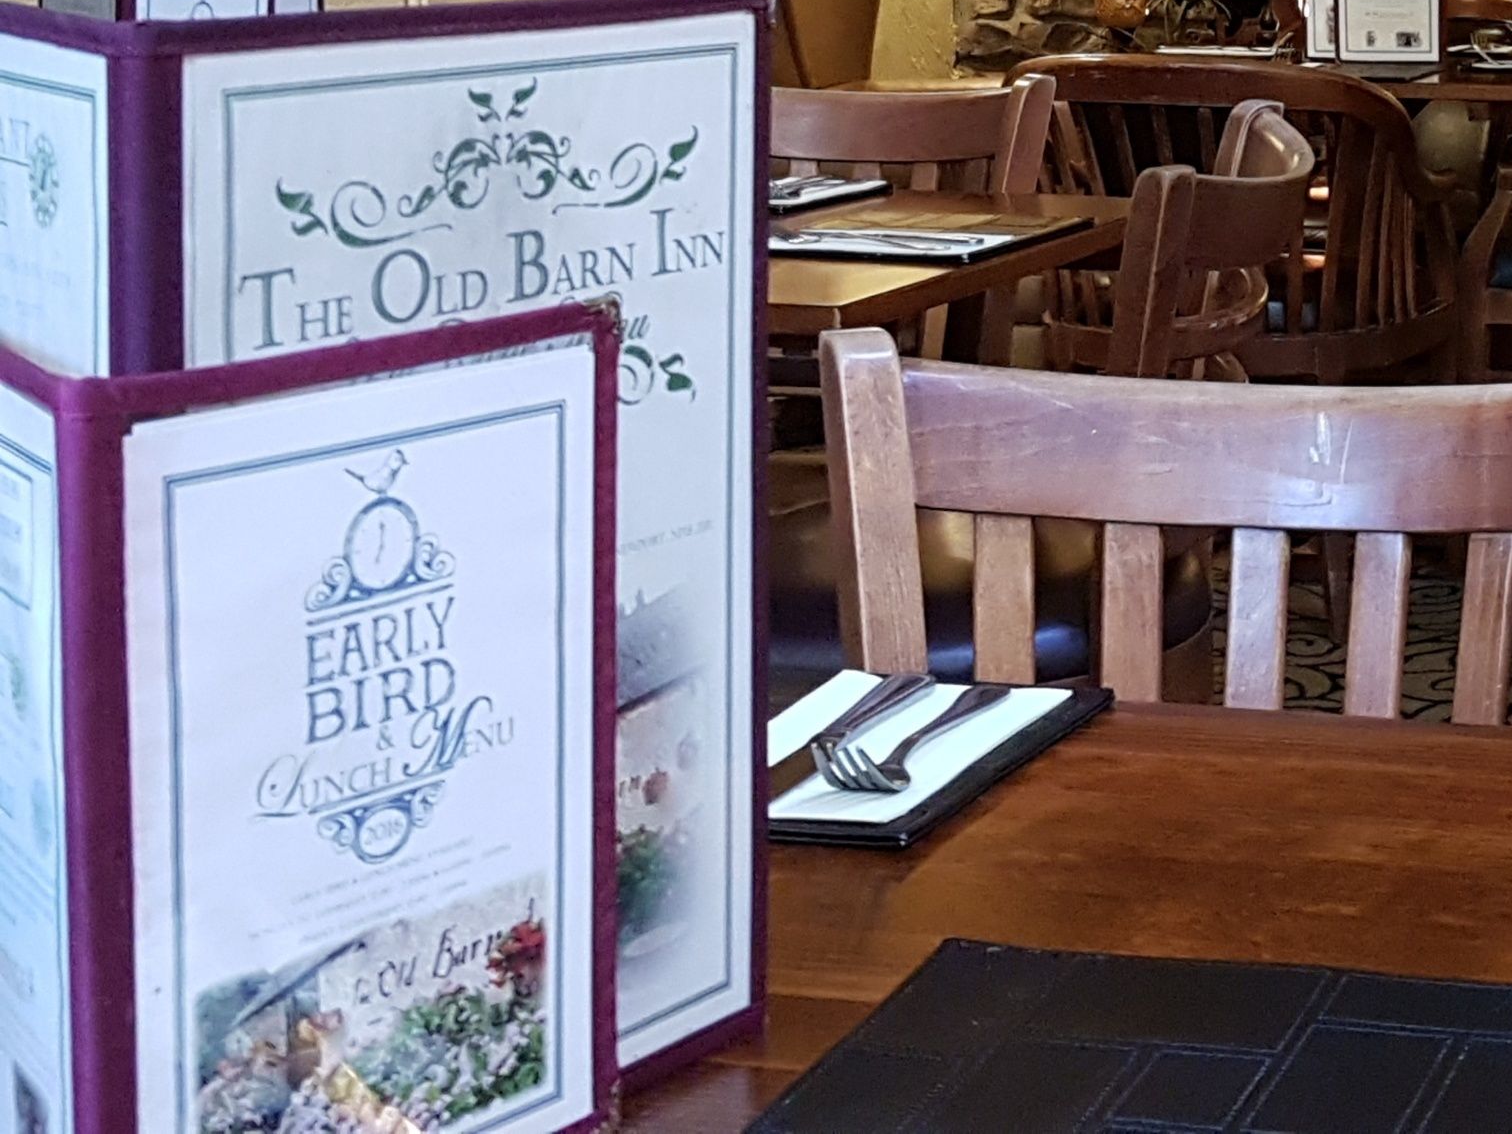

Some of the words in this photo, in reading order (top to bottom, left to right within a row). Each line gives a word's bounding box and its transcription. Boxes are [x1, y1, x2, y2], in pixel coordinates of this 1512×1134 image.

[238, 268, 354, 351] THE
[371, 248, 489, 324] OLD
[506, 229, 638, 303] BARN
[650, 208, 726, 277] INN
[304, 597, 455, 688] EARLY
[304, 657, 456, 745] BIRD
[375, 725, 395, 752] &
[254, 752, 392, 817] LUNCH
[403, 696, 515, 777] MENU
